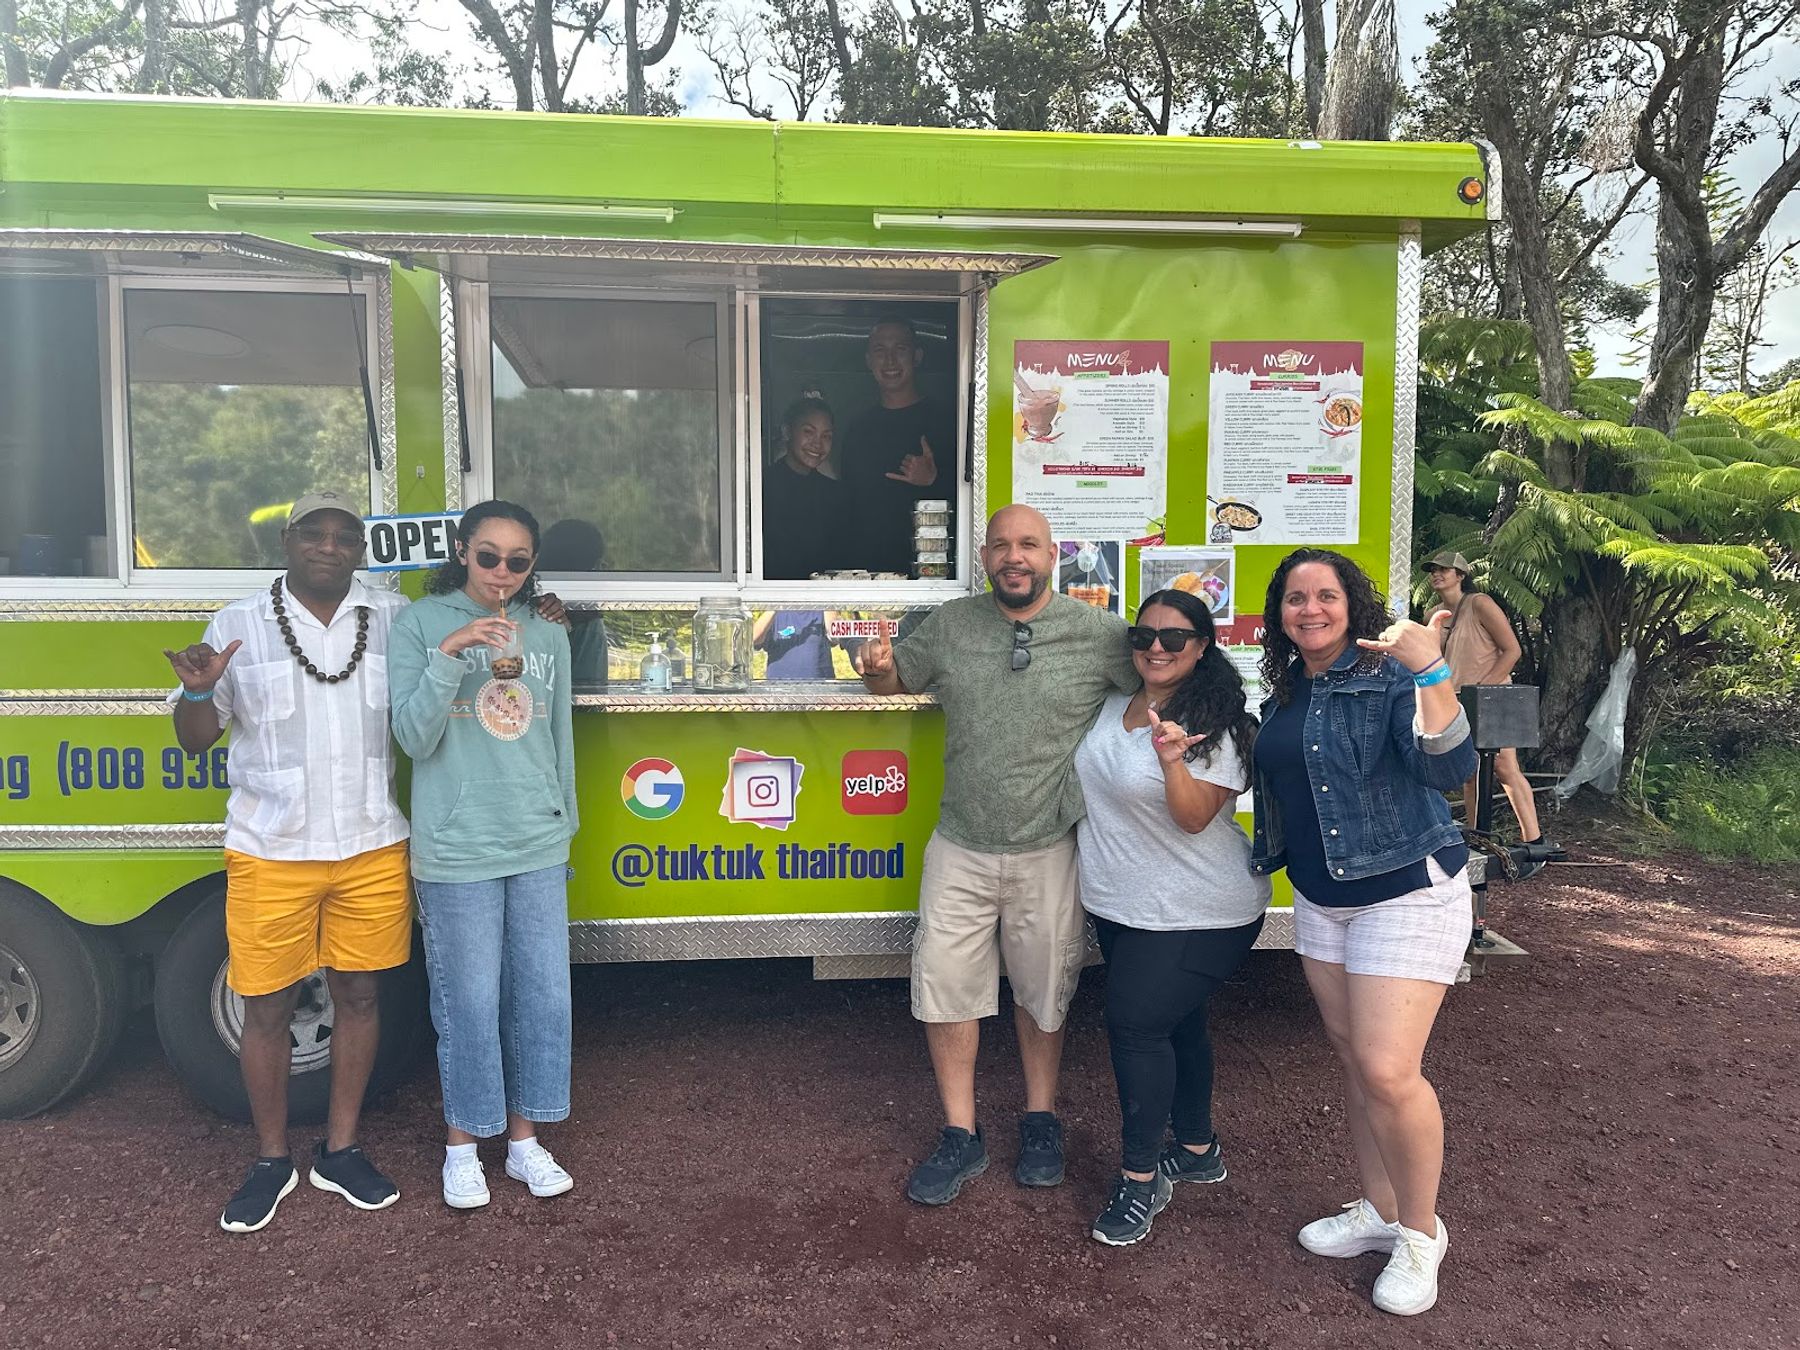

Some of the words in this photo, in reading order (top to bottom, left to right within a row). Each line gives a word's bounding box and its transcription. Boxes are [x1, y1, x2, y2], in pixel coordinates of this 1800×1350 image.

[1067, 353, 1120, 368] MENU
[1263, 353, 1315, 369] MENU
[831, 622, 851, 636] CASH
[854, 622, 897, 636] PREFEED
[57, 741, 145, 796] (808
[161, 747, 230, 789] 936
[846, 775, 886, 795] yelp
[776, 842, 904, 880] thaifood
